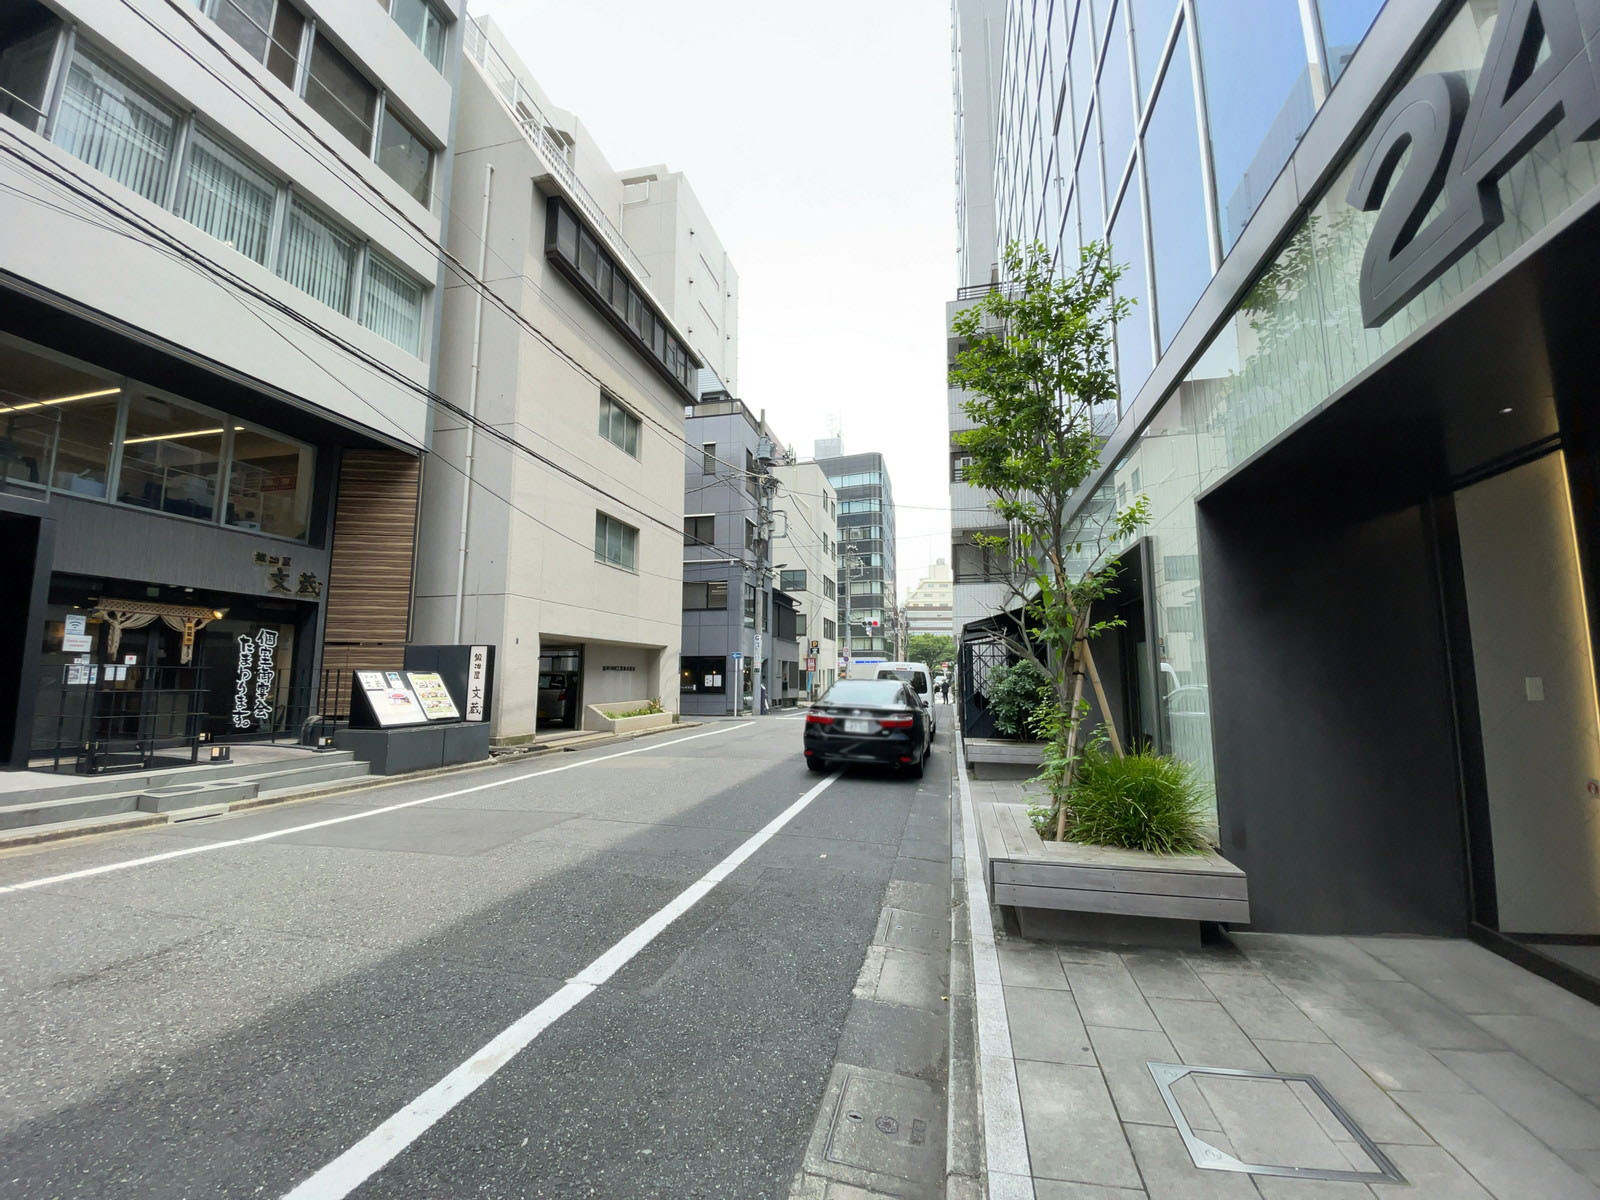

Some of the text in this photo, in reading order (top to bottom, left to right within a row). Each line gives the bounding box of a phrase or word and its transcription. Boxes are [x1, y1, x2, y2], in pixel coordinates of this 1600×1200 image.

[1346, 0, 1600, 328] 24
[254, 627, 279, 720] 個室御宴会
